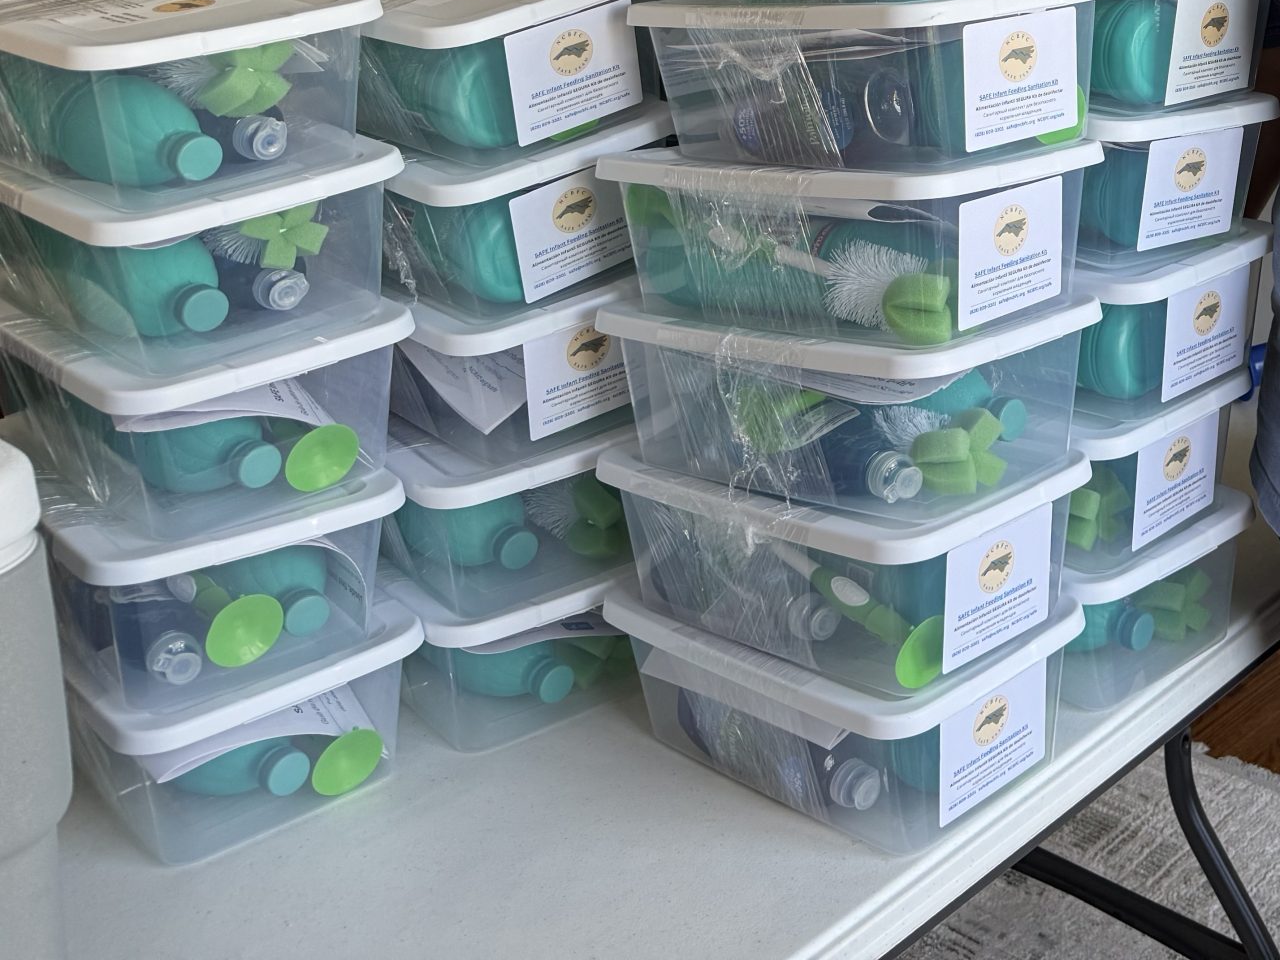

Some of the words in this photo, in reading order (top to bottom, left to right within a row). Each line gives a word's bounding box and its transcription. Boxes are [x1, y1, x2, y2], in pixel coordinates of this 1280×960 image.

[531, 90, 545, 99] SAFE
[546, 84, 563, 94] Infant
[563, 76, 584, 89] Feeding
[585, 67, 612, 81] Sanitation
[979, 93, 991, 101] SAFE
[993, 90, 1007, 98] Infant
[1008, 85, 1026, 96] Feeding
[1028, 80, 1051, 91] Sanitation
